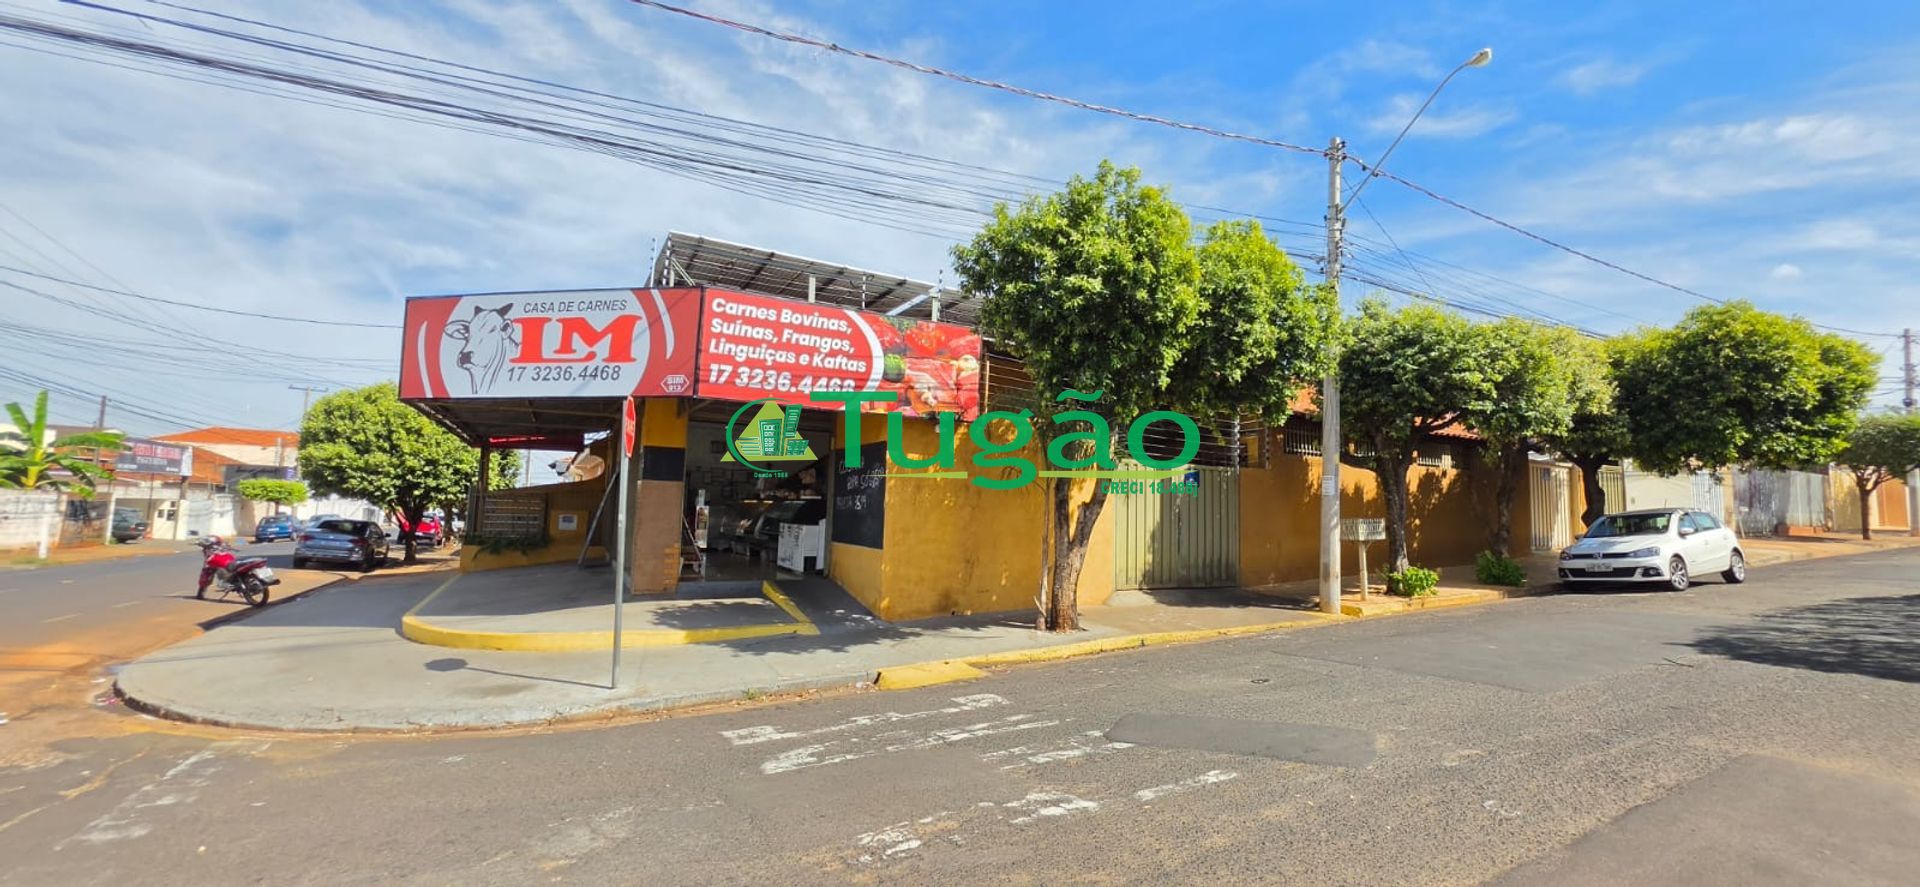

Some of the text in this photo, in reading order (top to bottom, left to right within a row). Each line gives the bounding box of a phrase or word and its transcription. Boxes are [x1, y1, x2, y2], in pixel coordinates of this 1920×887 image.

[523, 299, 628, 313] CASA DE CARNES
[711, 298, 852, 334] Carnes Bovinas,
[509, 314, 643, 364] LM
[710, 318, 854, 353] Suínas, Frangos,
[507, 365, 621, 381] 17 3236.4468
[709, 338, 867, 373] Linguiças e Kaftas
[708, 363, 856, 394] 17 3236.4468
